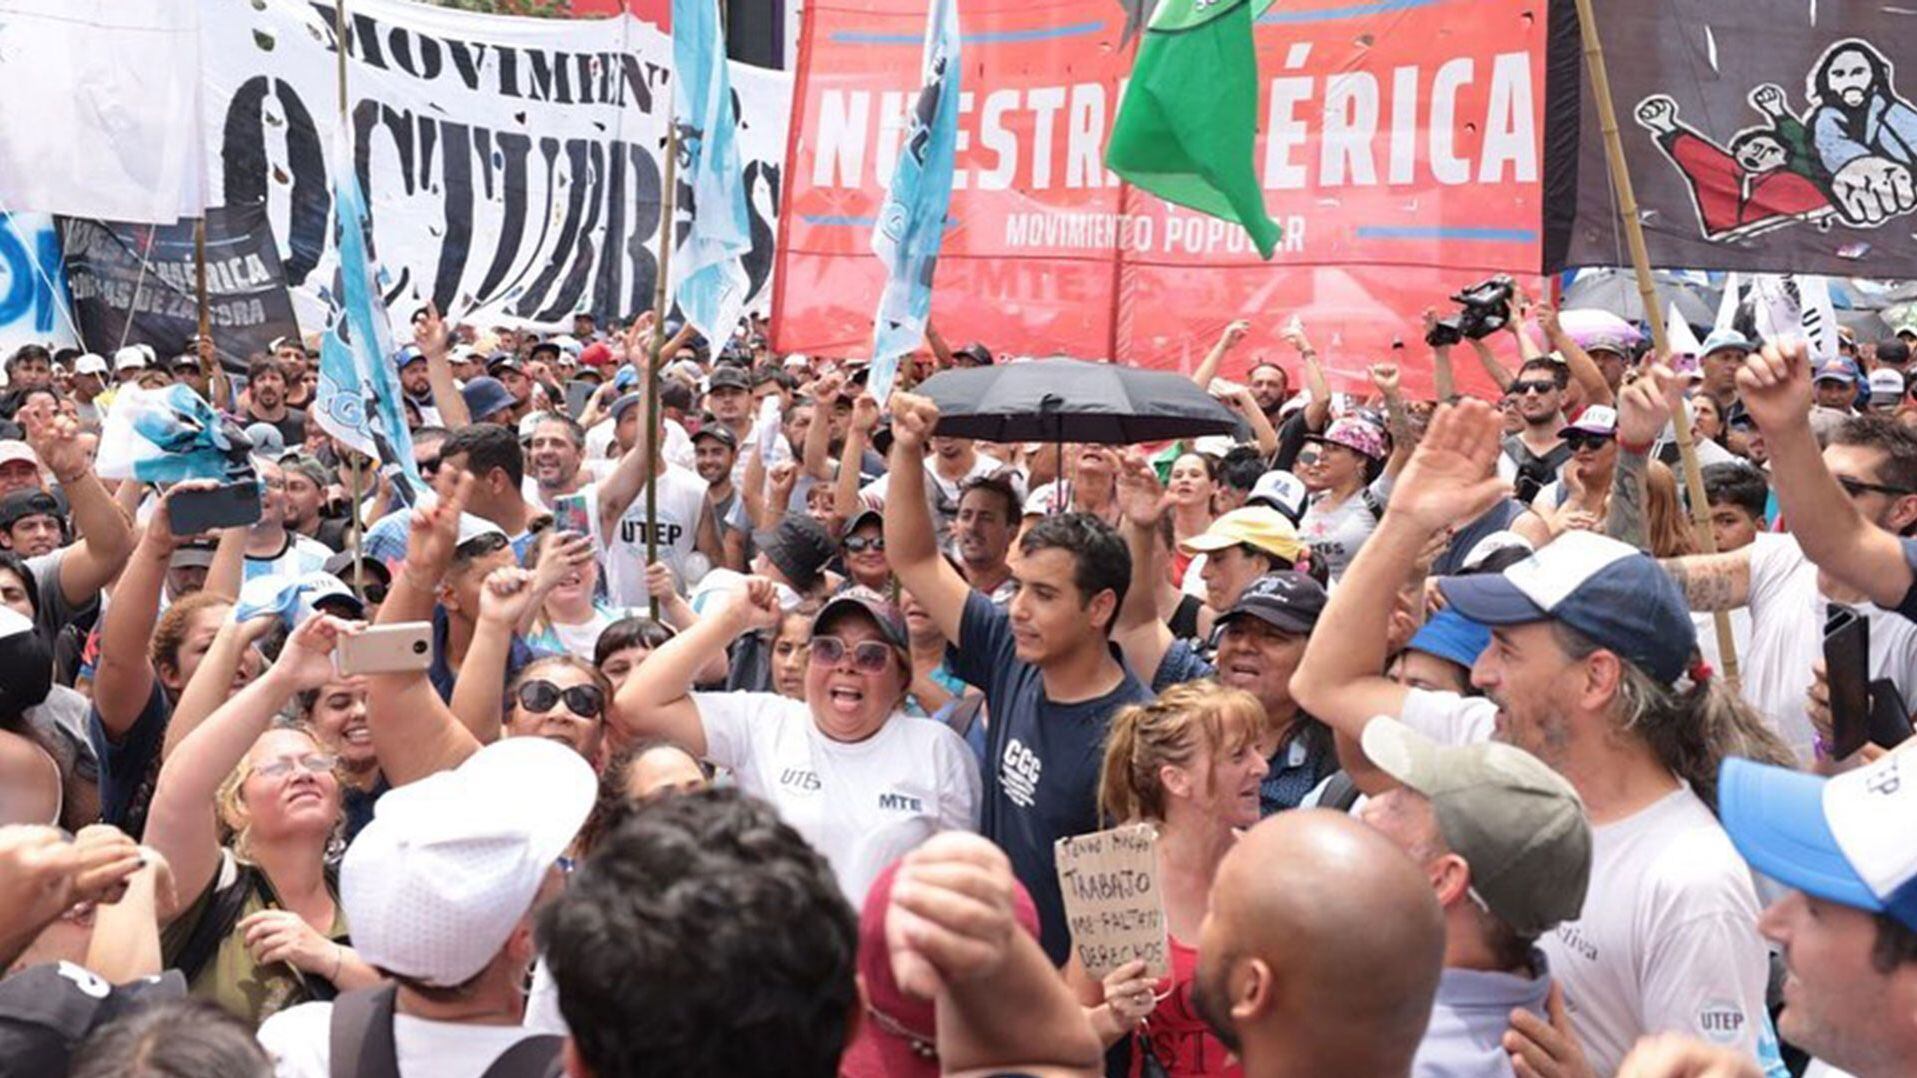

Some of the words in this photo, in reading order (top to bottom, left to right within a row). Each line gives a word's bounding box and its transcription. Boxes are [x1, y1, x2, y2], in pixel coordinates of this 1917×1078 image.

[812, 78, 1130, 191] NUESTR
[1263, 40, 1538, 191] ÉRICA
[1163, 214, 1306, 254] POPUR
[621, 520, 682, 545] UTEP
[1003, 738, 1042, 785] CCC
[878, 792, 923, 813] MTE
[1700, 1011, 1745, 1032] UTEP
